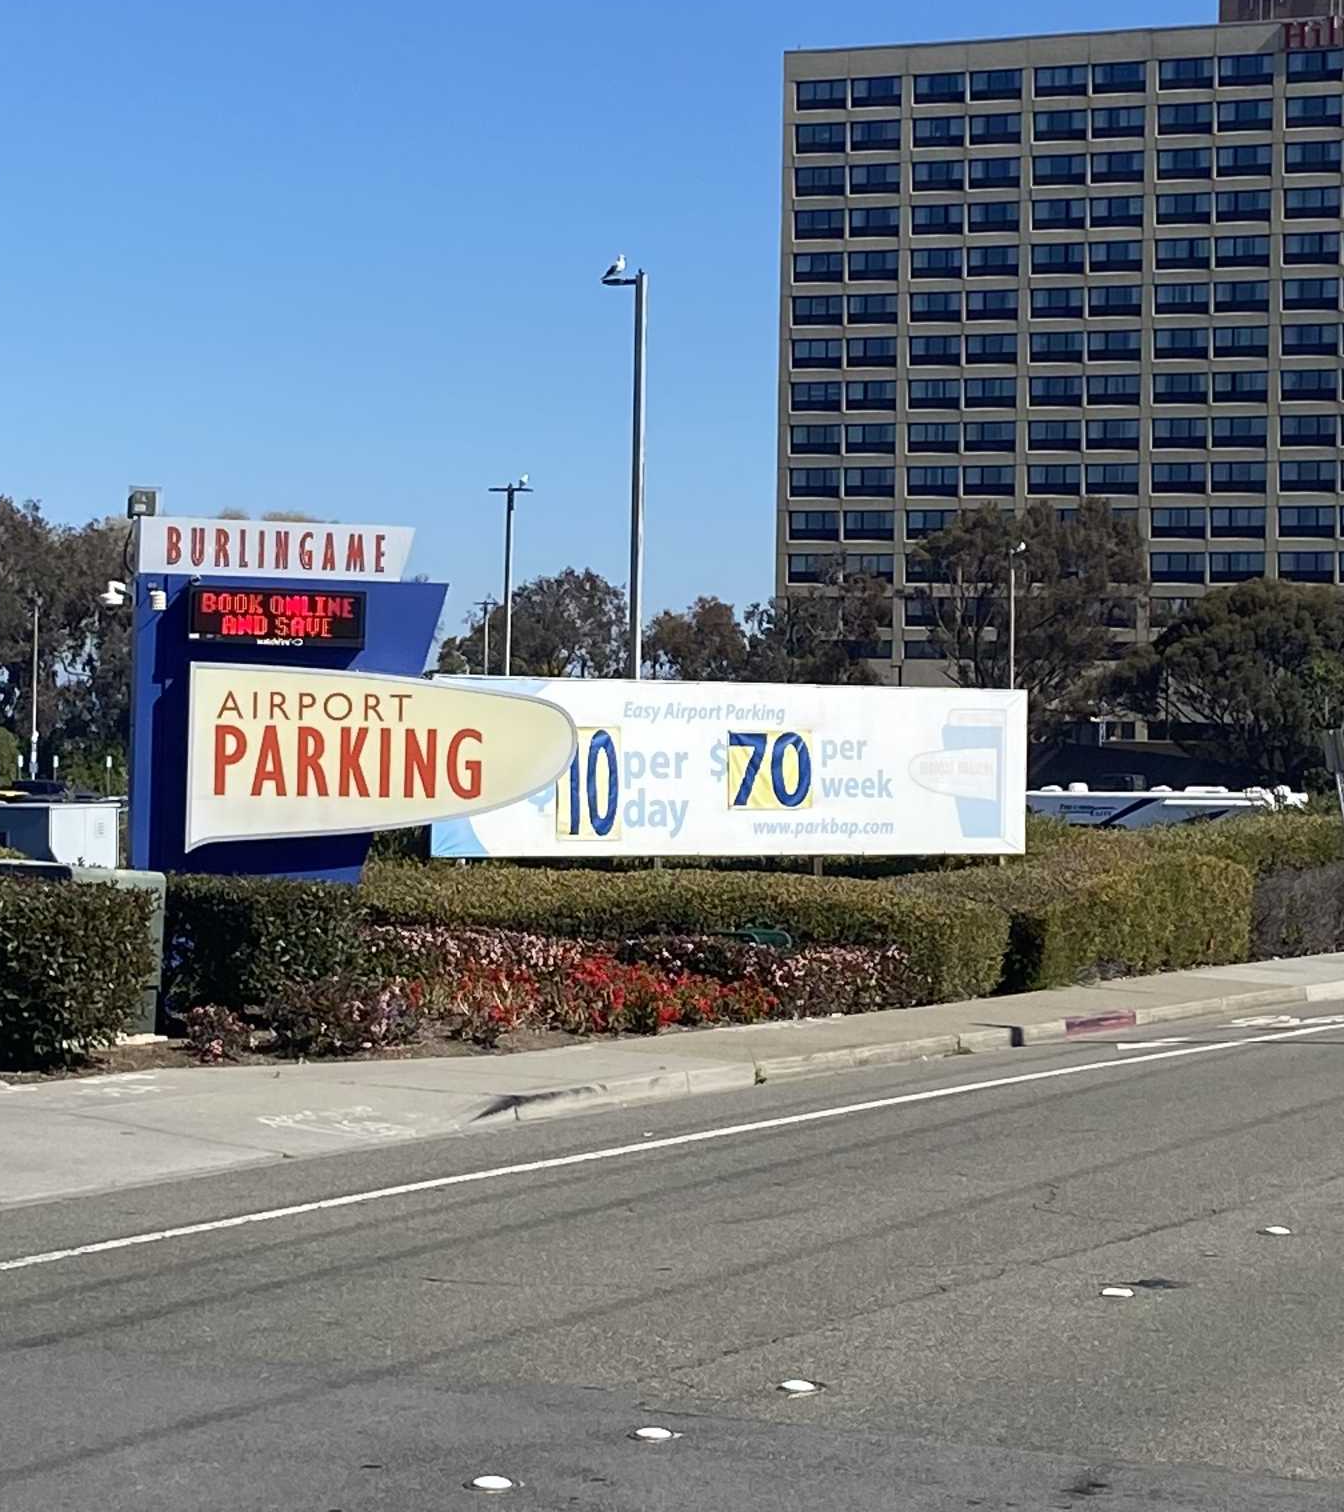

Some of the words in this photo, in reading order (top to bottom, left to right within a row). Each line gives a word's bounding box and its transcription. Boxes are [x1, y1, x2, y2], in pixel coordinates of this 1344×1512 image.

[165, 525, 387, 574] BURLINGAME
[201, 592, 264, 614] BOOK
[269, 594, 355, 618] ONLINE
[221, 614, 268, 636] AND
[274, 617, 333, 638] SAVE
[217, 690, 414, 723] AIRPORT
[623, 701, 661, 724] Easy
[663, 702, 721, 724] Airport
[725, 704, 786, 726] Parking
[213, 724, 483, 800] PARKING
[821, 738, 868, 768] per
[623, 750, 689, 789] per
[820, 769, 894, 799] week
[623, 788, 690, 839] day
[752, 818, 895, 837] www.parkbap.com
